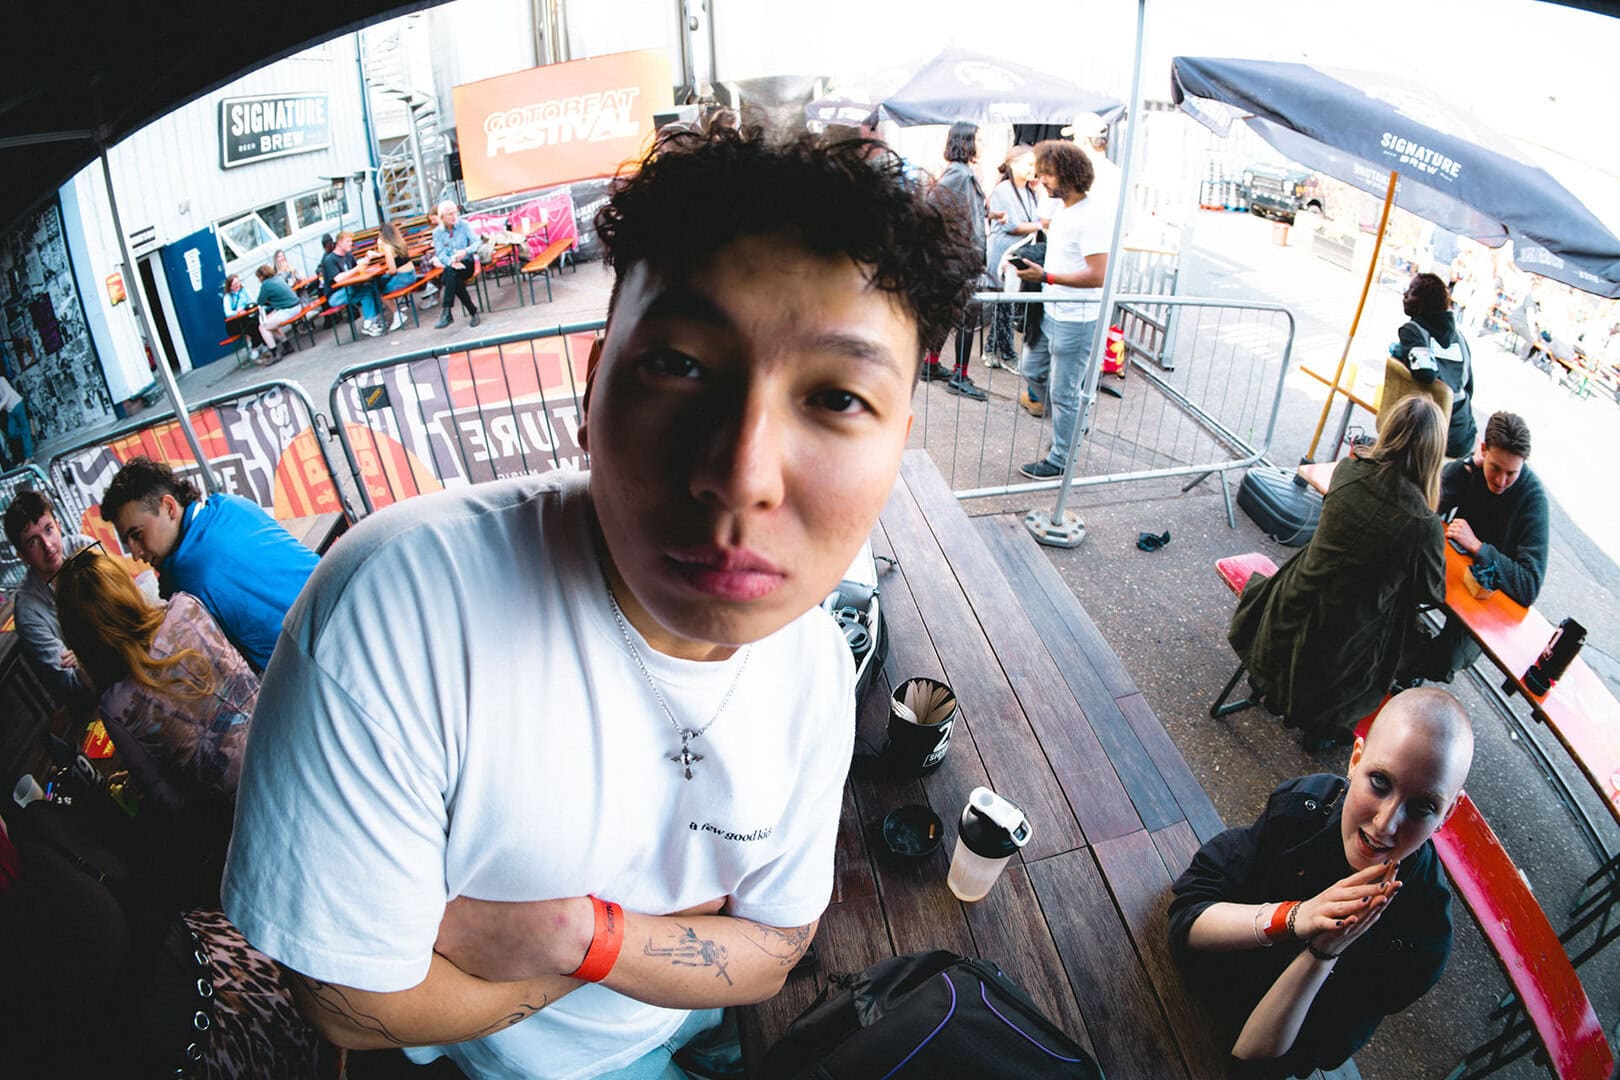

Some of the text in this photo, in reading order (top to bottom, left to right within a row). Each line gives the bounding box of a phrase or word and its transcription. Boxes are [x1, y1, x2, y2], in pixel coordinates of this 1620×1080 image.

[231, 99, 325, 136] SIGNATURE
[486, 107, 640, 157] FESTIVAL
[260, 132, 304, 152] BREW
[1381, 132, 1462, 178] SIGNATURE
[1399, 155, 1438, 175] BREW
[689, 821, 698, 831] a
[701, 822, 725, 835] few
[724, 830, 758, 842] good
